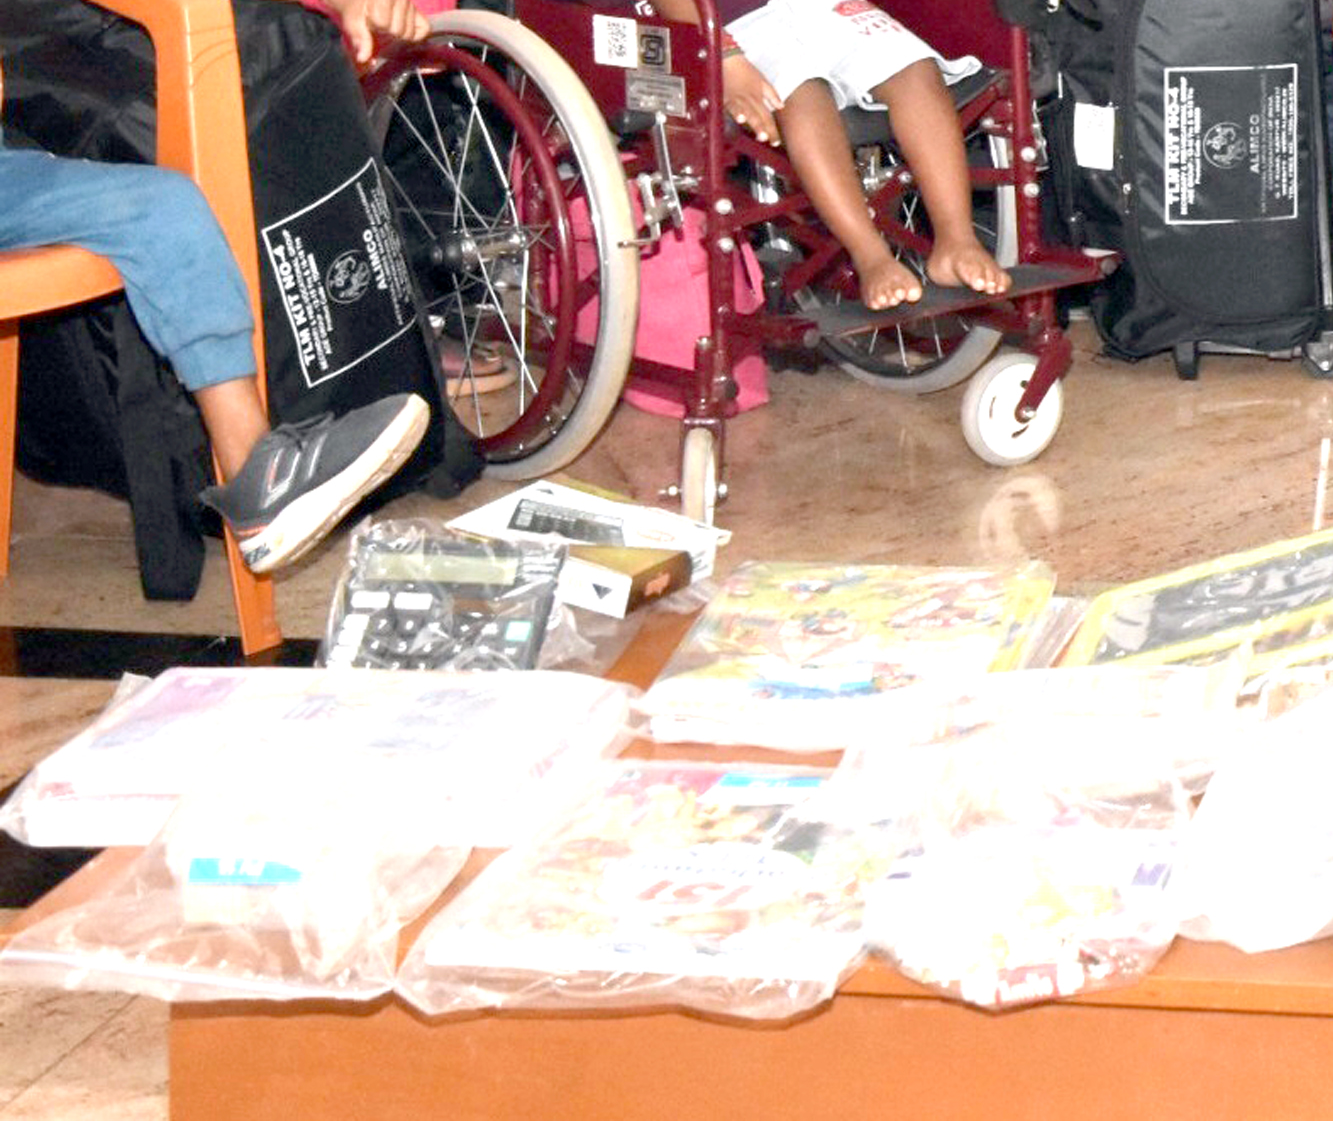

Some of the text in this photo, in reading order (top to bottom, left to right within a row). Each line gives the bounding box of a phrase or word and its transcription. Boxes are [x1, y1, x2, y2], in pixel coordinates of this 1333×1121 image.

[1168, 133, 1179, 163] KIT
[1250, 114, 1259, 173] ALIMCO
[1168, 169, 1180, 205] TLM
[363, 229, 388, 289] ALIMCO
[273, 245, 315, 366] TLM KIT NO-4
[317, 314, 327, 337] GROUP
[322, 340, 332, 354] AGE
